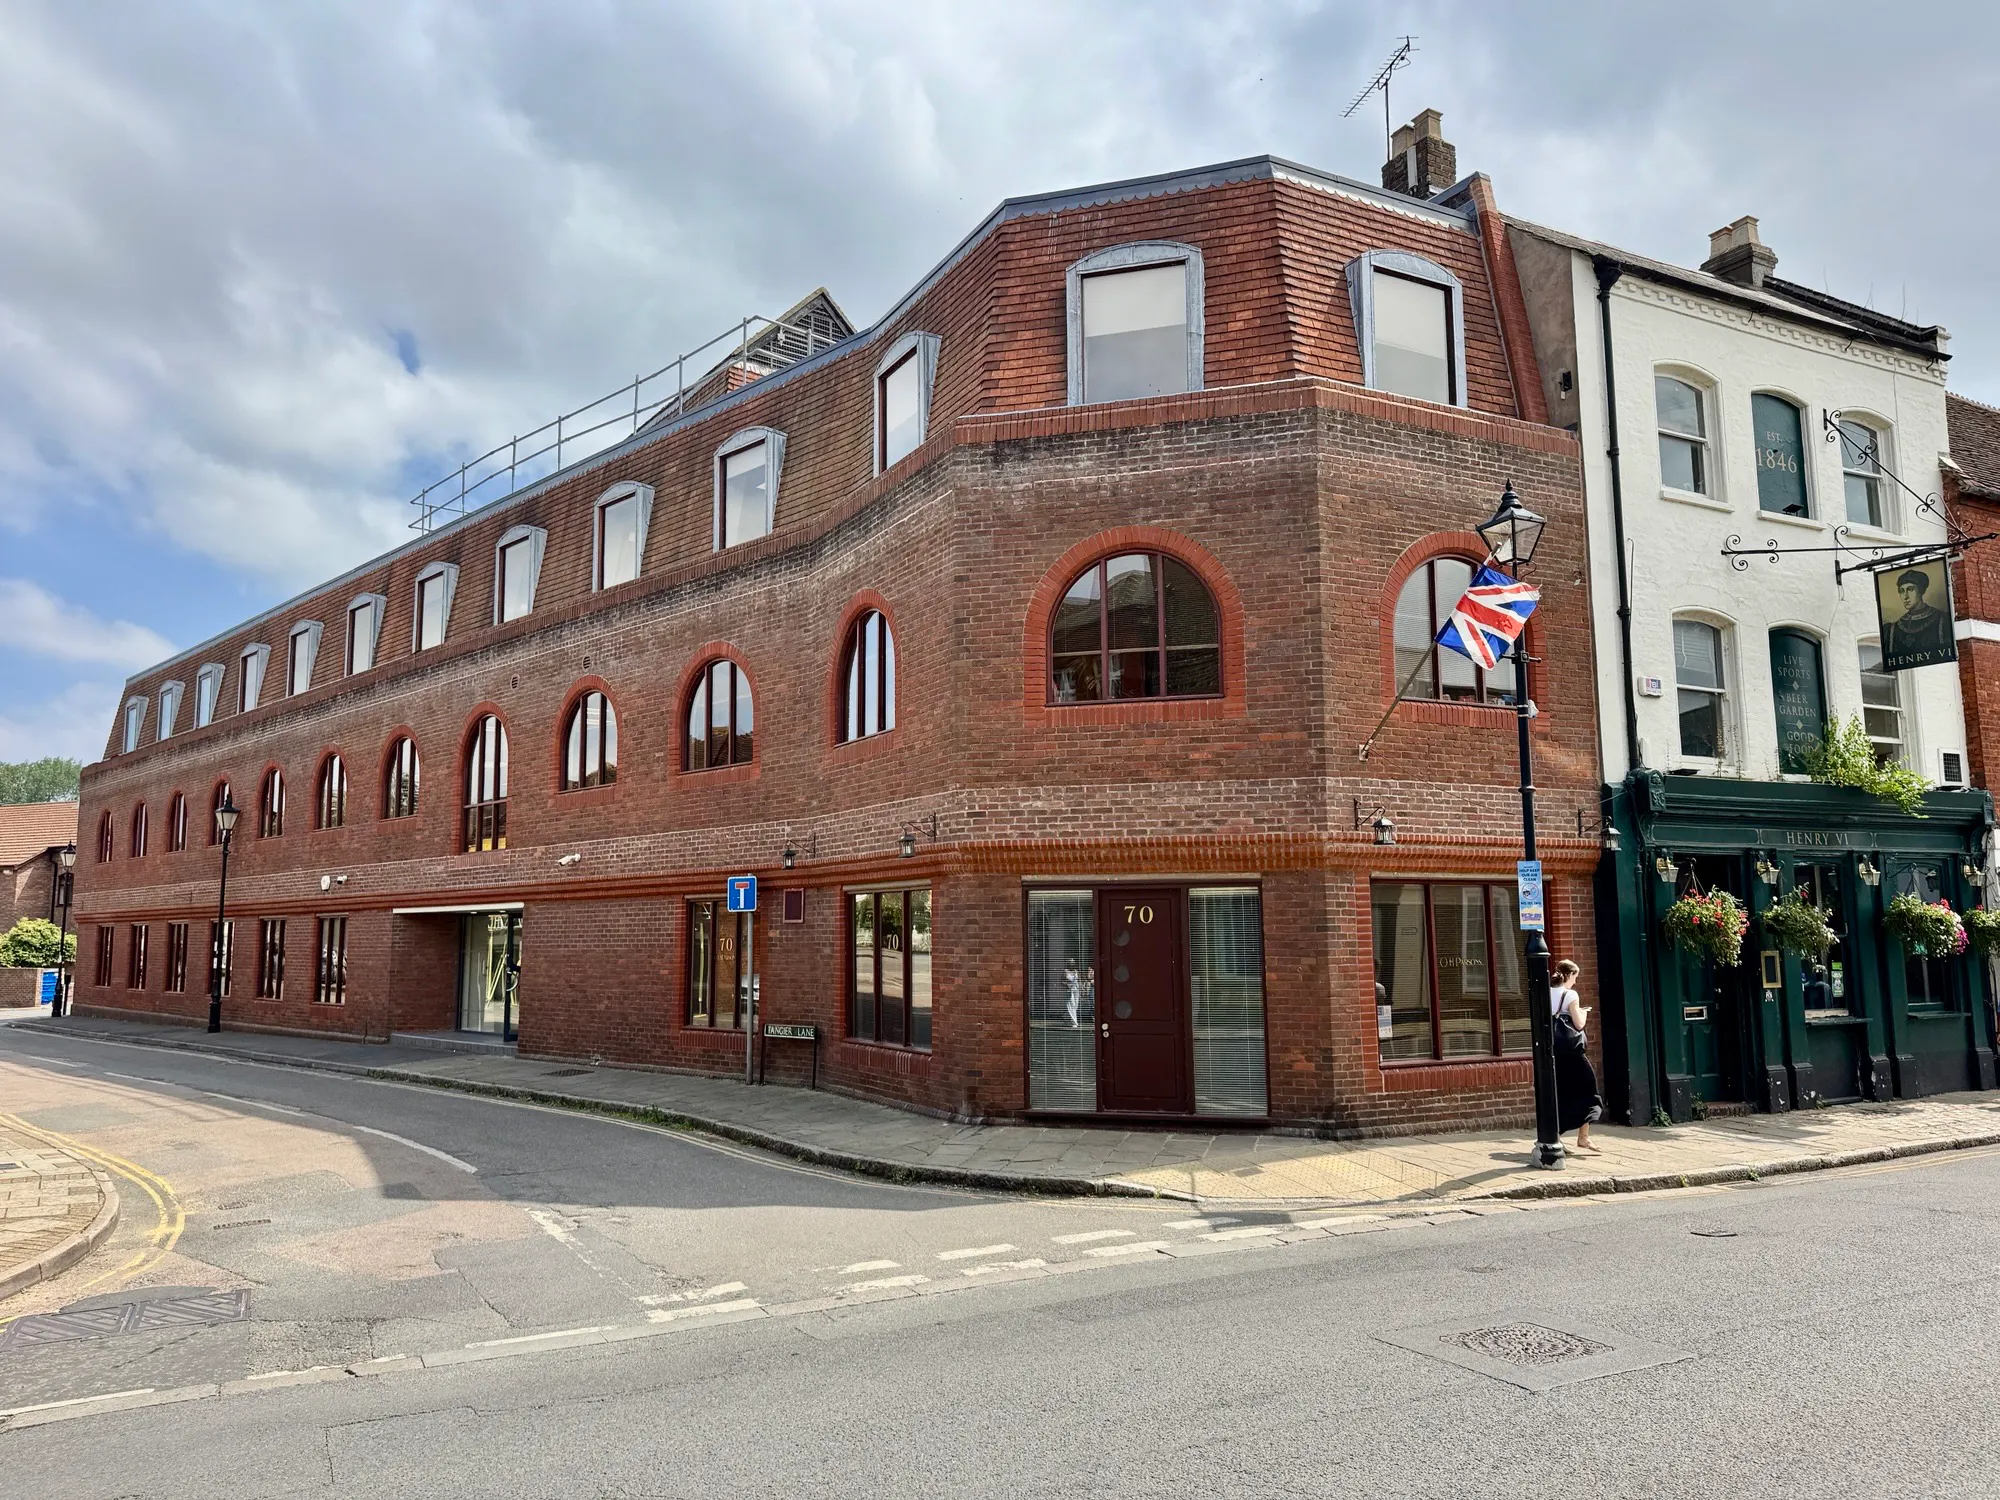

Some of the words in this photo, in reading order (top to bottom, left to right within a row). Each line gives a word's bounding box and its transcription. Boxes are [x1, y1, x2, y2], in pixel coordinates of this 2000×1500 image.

[1755, 447, 1797, 474] 1846
[1783, 655, 1804, 666] LIVE
[1888, 651, 1932, 667] HENRY
[1938, 648, 1952, 657] VI
[1777, 666, 1811, 680] SPORTS
[1786, 693, 1808, 704] BEER
[1779, 705, 1817, 717] GARDEN
[1787, 731, 1815, 743] GOOD
[1786, 831, 1829, 846] HENRY
[1836, 833, 1849, 845] VI
[1124, 905, 1154, 924] 70
[719, 937, 733, 951] 70
[886, 934, 899, 950] 70
[767, 1025, 793, 1036] TANGIER
[797, 1027, 815, 1037] LANE
